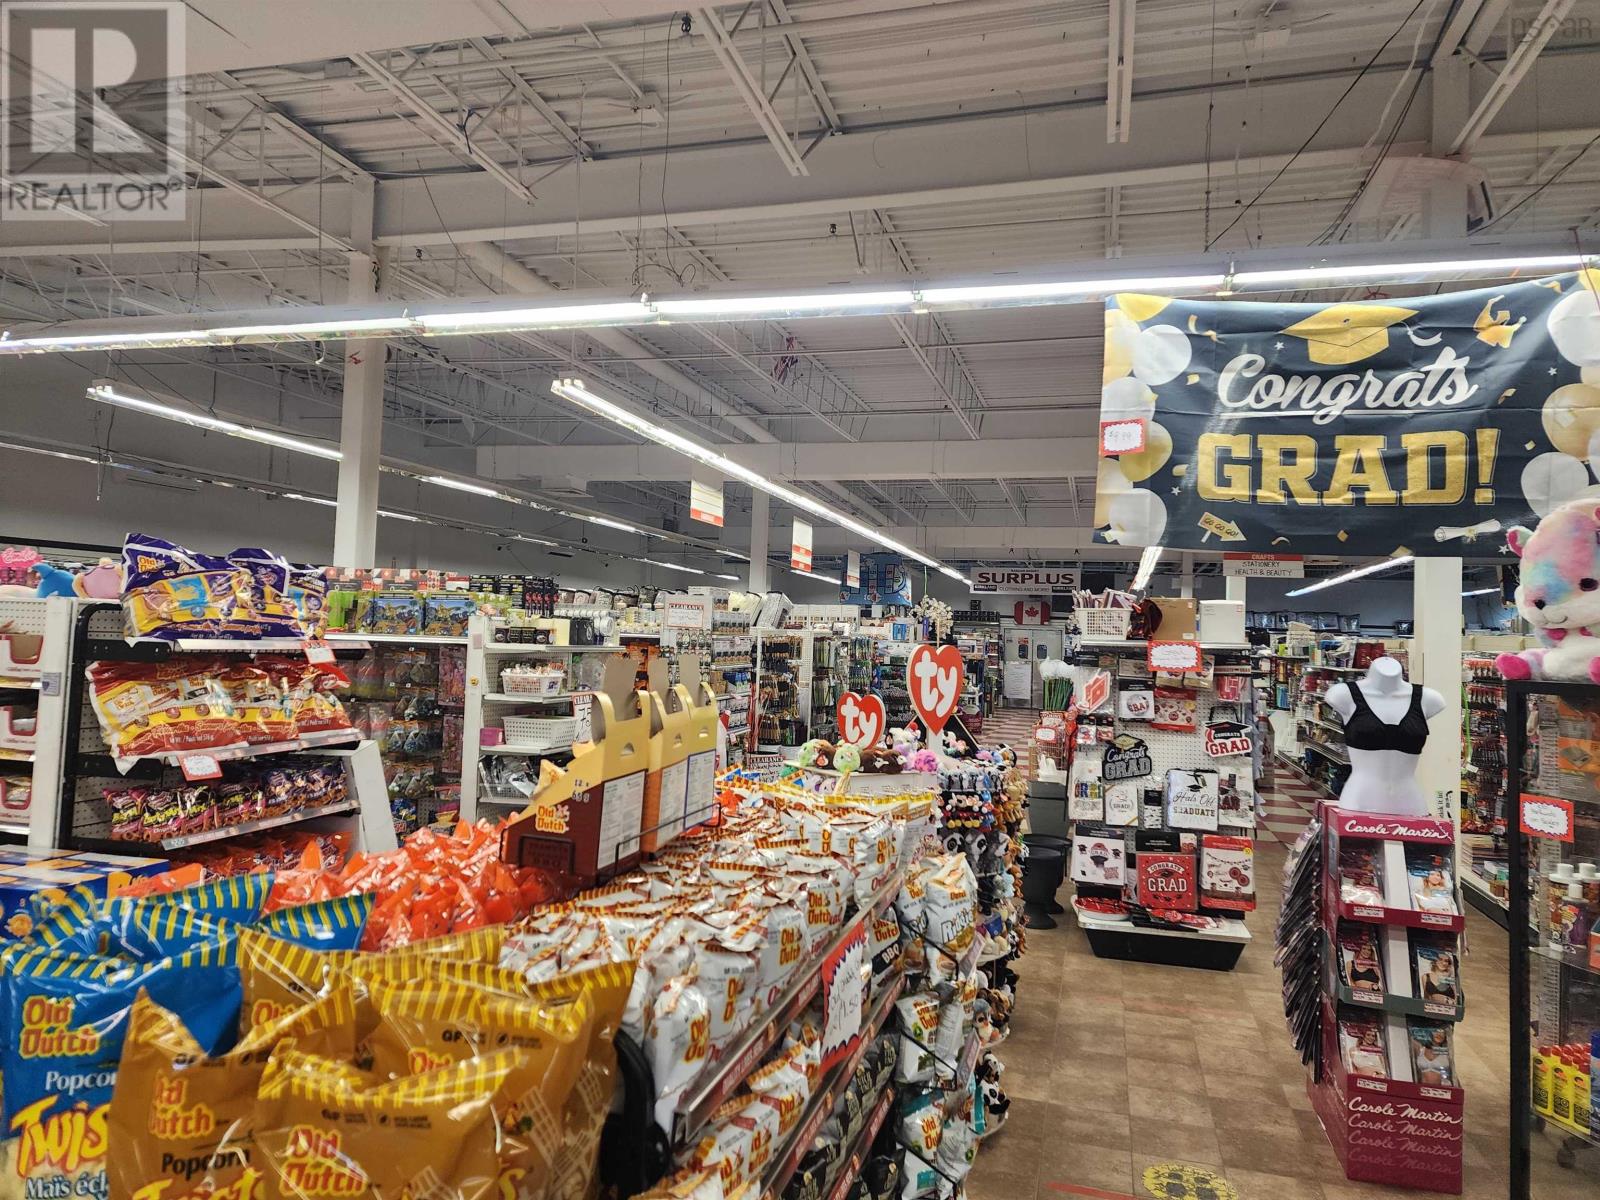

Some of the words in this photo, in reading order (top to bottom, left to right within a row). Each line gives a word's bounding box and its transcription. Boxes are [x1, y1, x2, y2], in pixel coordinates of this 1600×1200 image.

[1217, 346, 1479, 425] Congrats
[1197, 428, 1500, 506] GRAD!
[978, 572, 1074, 585] SURPLUS
[914, 650, 958, 718] ty
[840, 696, 878, 749] ty
[1107, 747, 1146, 763] Congrats
[1210, 740, 1250, 755] GRAD
[1105, 757, 1151, 779] GRAD
[537, 818, 566, 832] Dutch
[538, 805, 555, 818] Old
[1345, 820, 1389, 835] Carole
[1388, 823, 1450, 840] Martin
[1150, 862, 1182, 873] CONGRATS
[808, 890, 823, 907] Old
[1148, 878, 1187, 892] GRAD
[882, 943, 900, 963] BBQ
[23, 995, 73, 1026] Old
[20, 1026, 99, 1058] Dutch
[45, 1071, 118, 1096] Popcor
[151, 1104, 213, 1138] utch
[1348, 1097, 1398, 1116] Carole
[1396, 1103, 1462, 1124] Martin
[9, 1094, 112, 1179] Twis
[1348, 1113, 1397, 1132] Carole
[1396, 1120, 1462, 1141] Martin
[289, 1126, 341, 1160] Old
[1348, 1130, 1396, 1149] Carole
[1396, 1137, 1462, 1158] Martin
[161, 1150, 250, 1181] Popcorn
[281, 1161, 368, 1195] Dutch
[25, 1175, 71, 1200] Maïs
